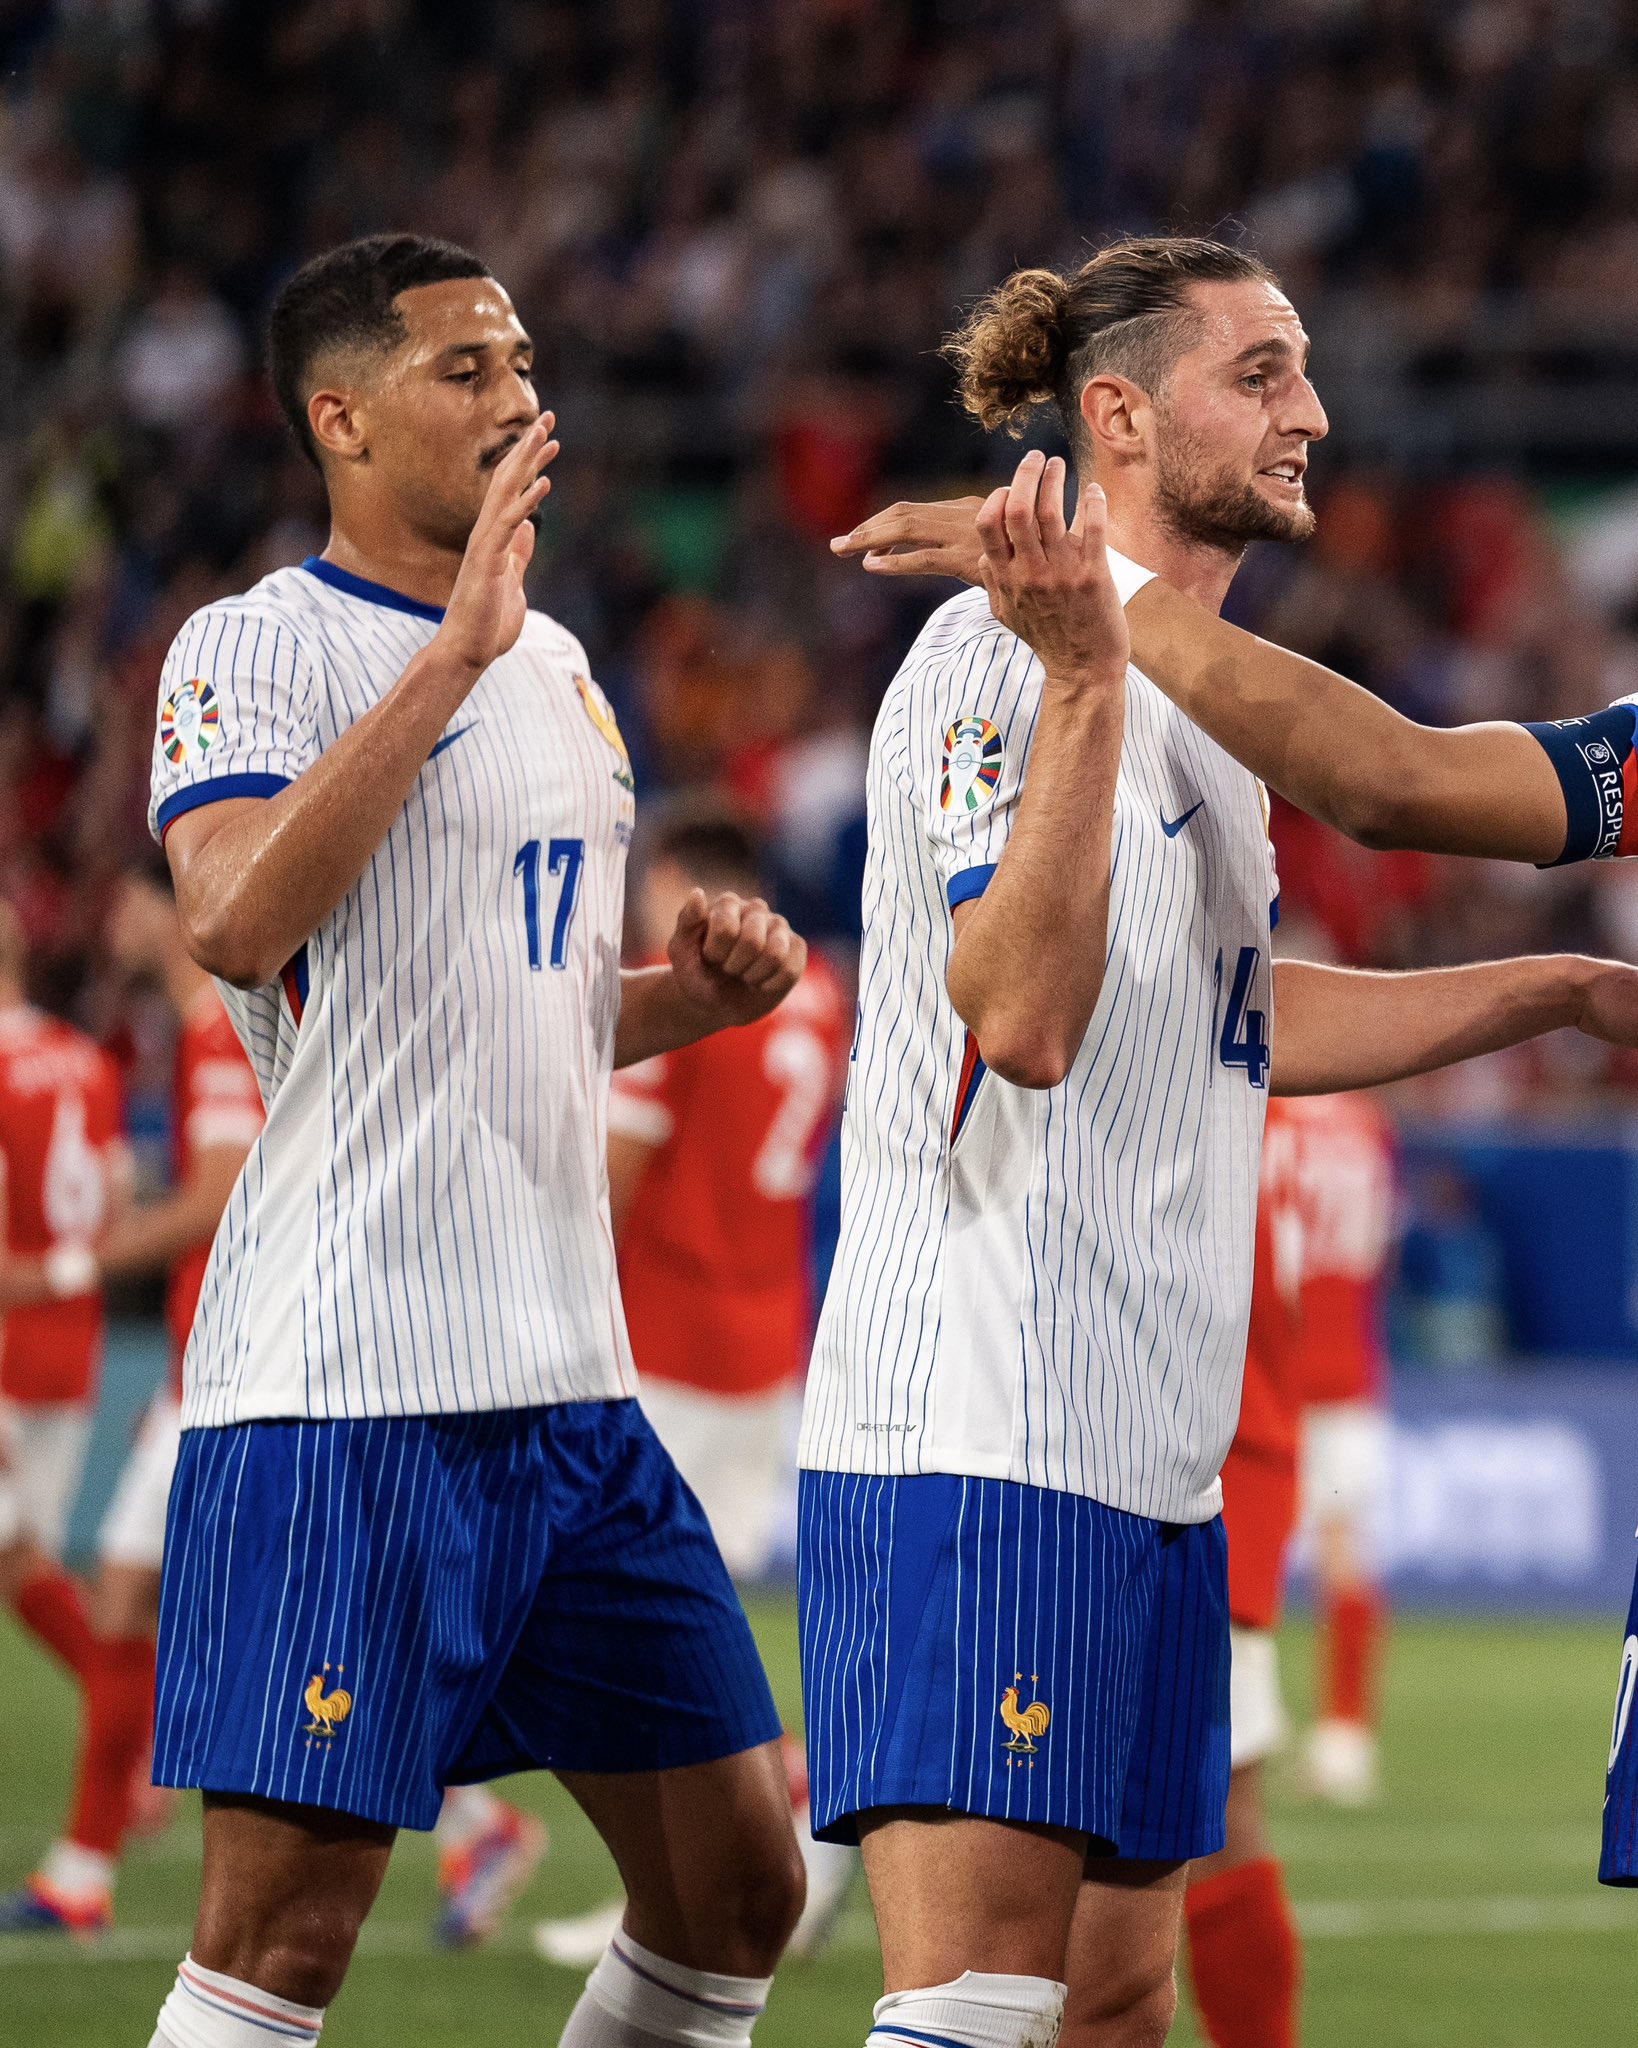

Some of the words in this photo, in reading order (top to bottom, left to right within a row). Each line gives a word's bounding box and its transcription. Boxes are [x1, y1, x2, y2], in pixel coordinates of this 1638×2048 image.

[1598, 771, 1624, 858] RESPEC
[513, 838, 585, 971] 17
[1209, 946, 1270, 1089] 14
